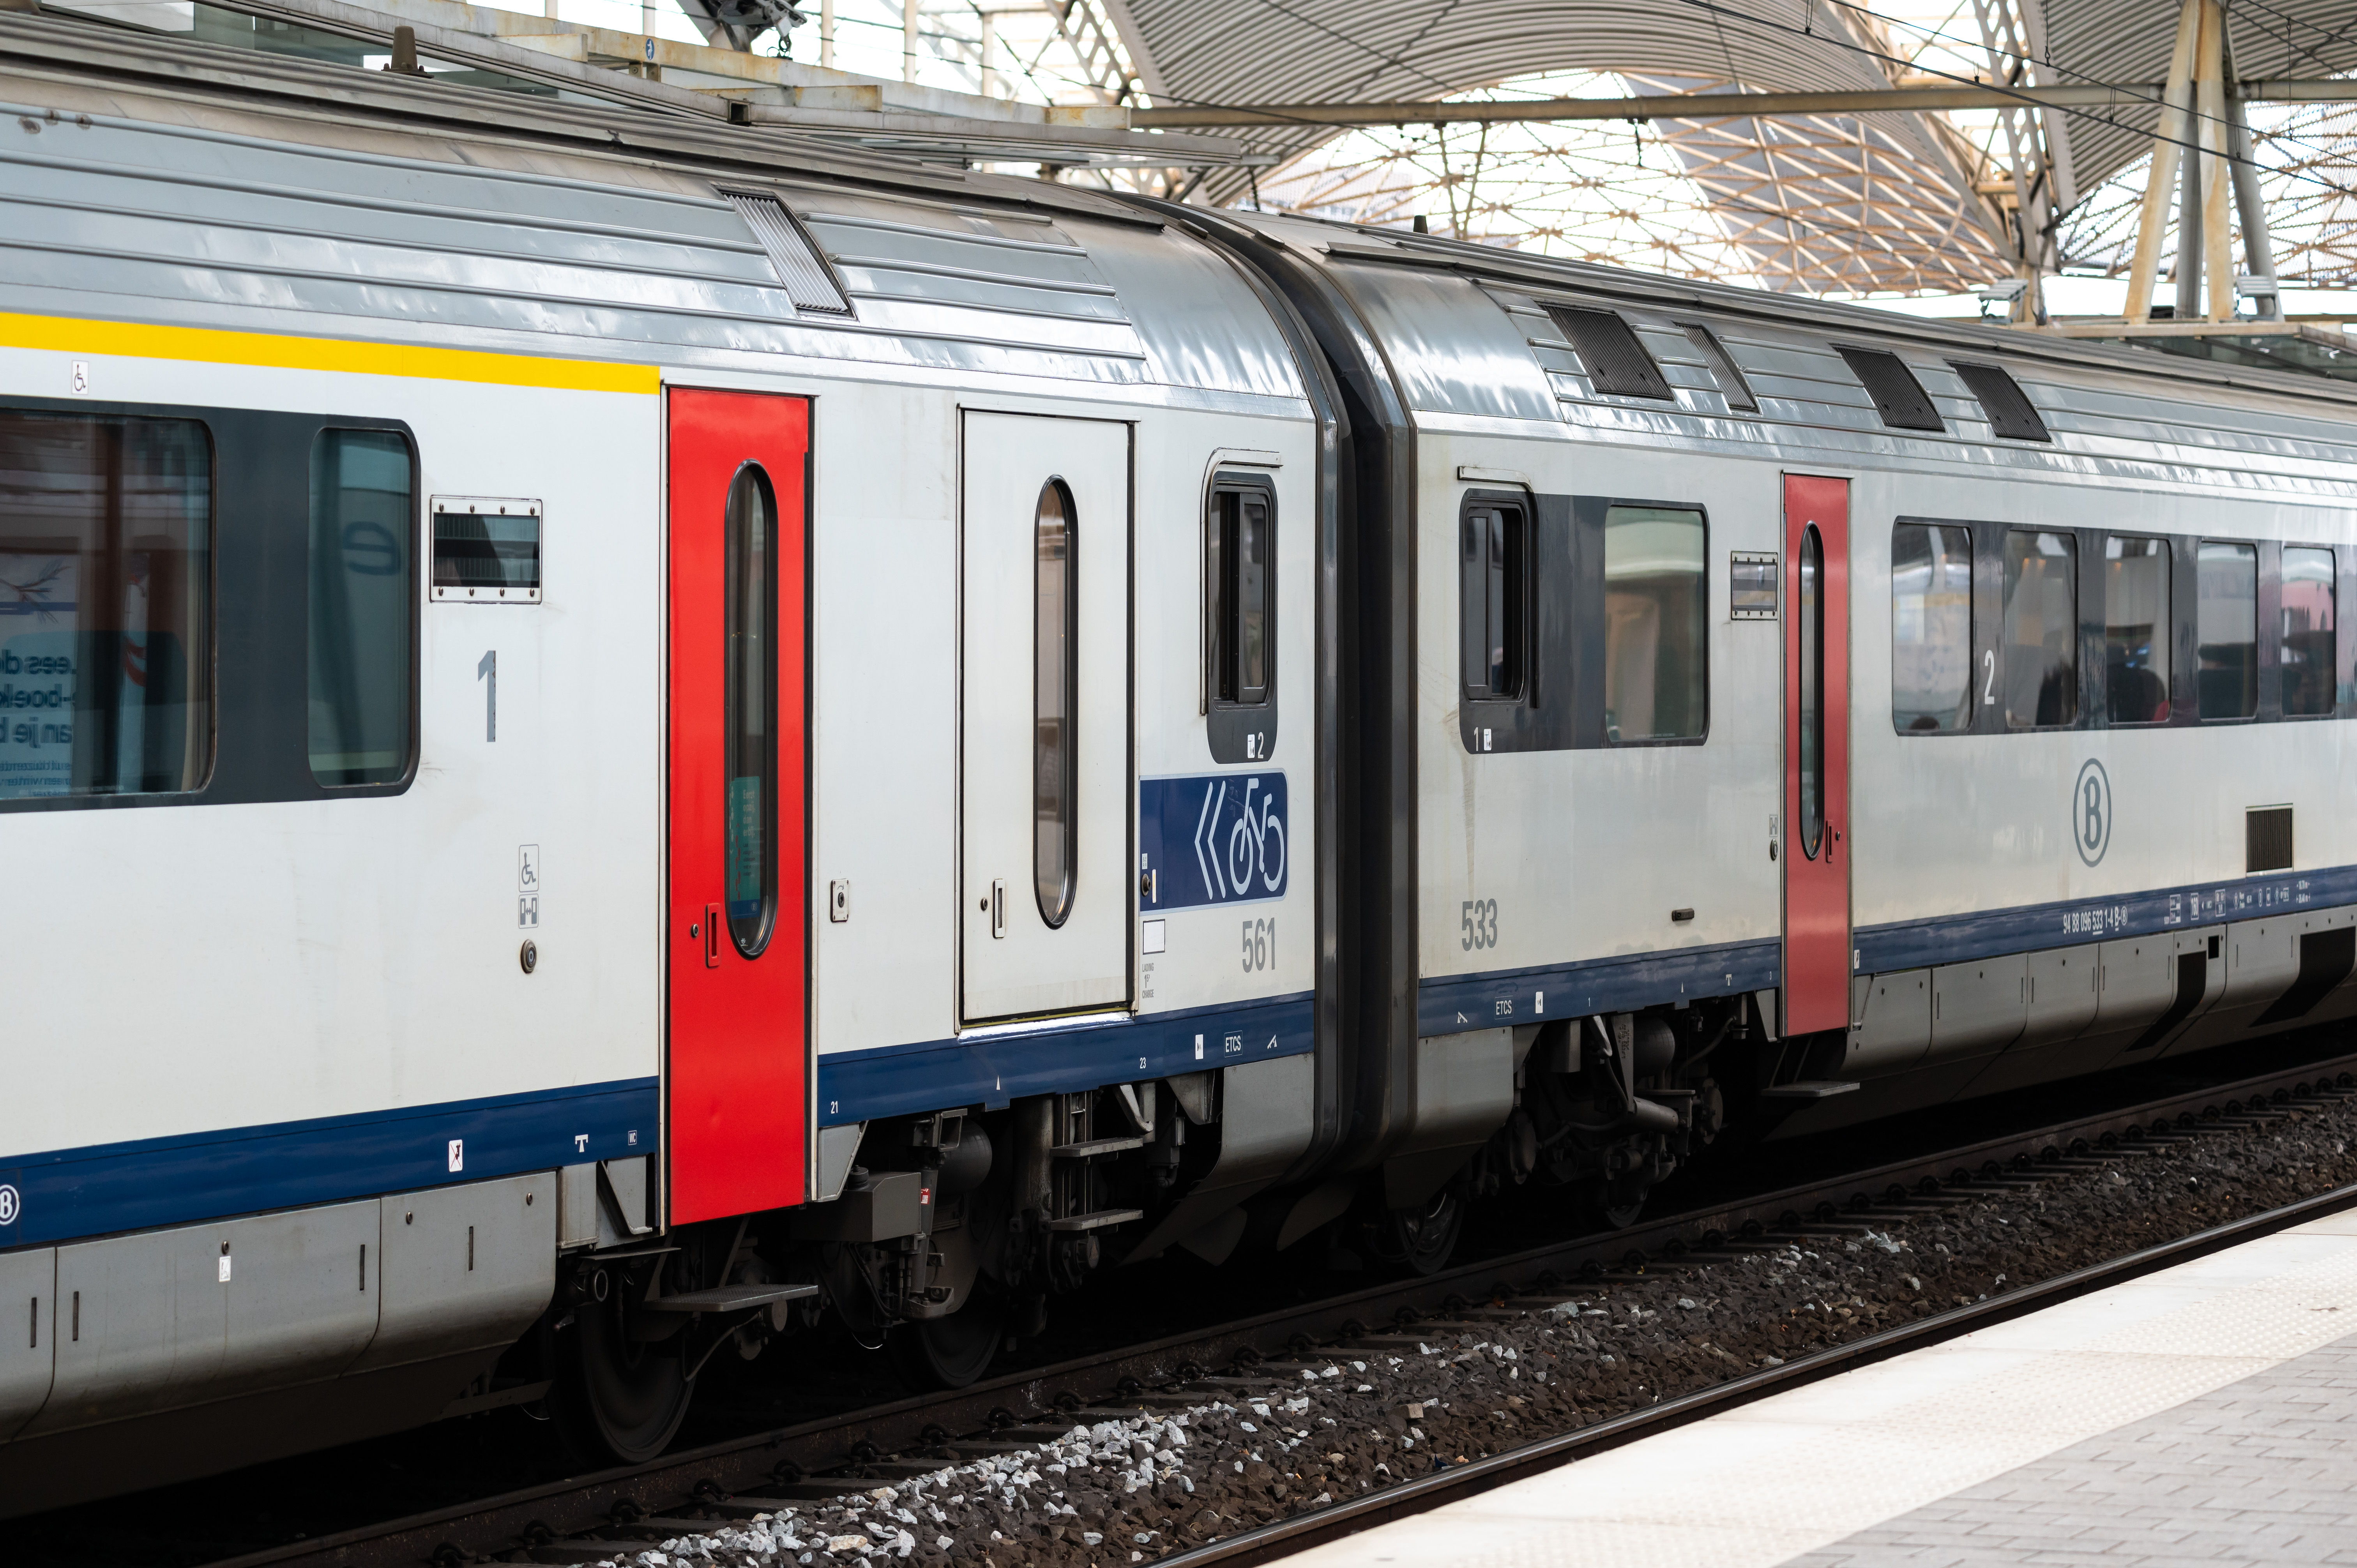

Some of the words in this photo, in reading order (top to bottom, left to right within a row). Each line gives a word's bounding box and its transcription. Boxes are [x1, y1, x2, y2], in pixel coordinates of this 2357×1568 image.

[1984, 650, 1995, 705] 2
[478, 650, 496, 742] 1
[1258, 731, 1263, 759] 2
[1474, 727, 1479, 751] 1
[1461, 898, 1498, 952] 533
[2064, 914, 2071, 934] 94
[2072, 912, 2080, 933] 88
[2081, 911, 2091, 932] 096
[2092, 909, 2103, 931] 533
[2104, 908, 2114, 928] 1-4
[1242, 917, 1275, 973] 561
[1142, 963, 1154, 972] LADING
[1142, 989, 1154, 999] CHARGE
[1496, 1000, 1512, 1015] ETCS
[1225, 1035, 1241, 1052] ETCS
[1140, 1057, 1146, 1069] 23
[831, 1101, 838, 1114] 21
[629, 1133, 636, 1143] WC
